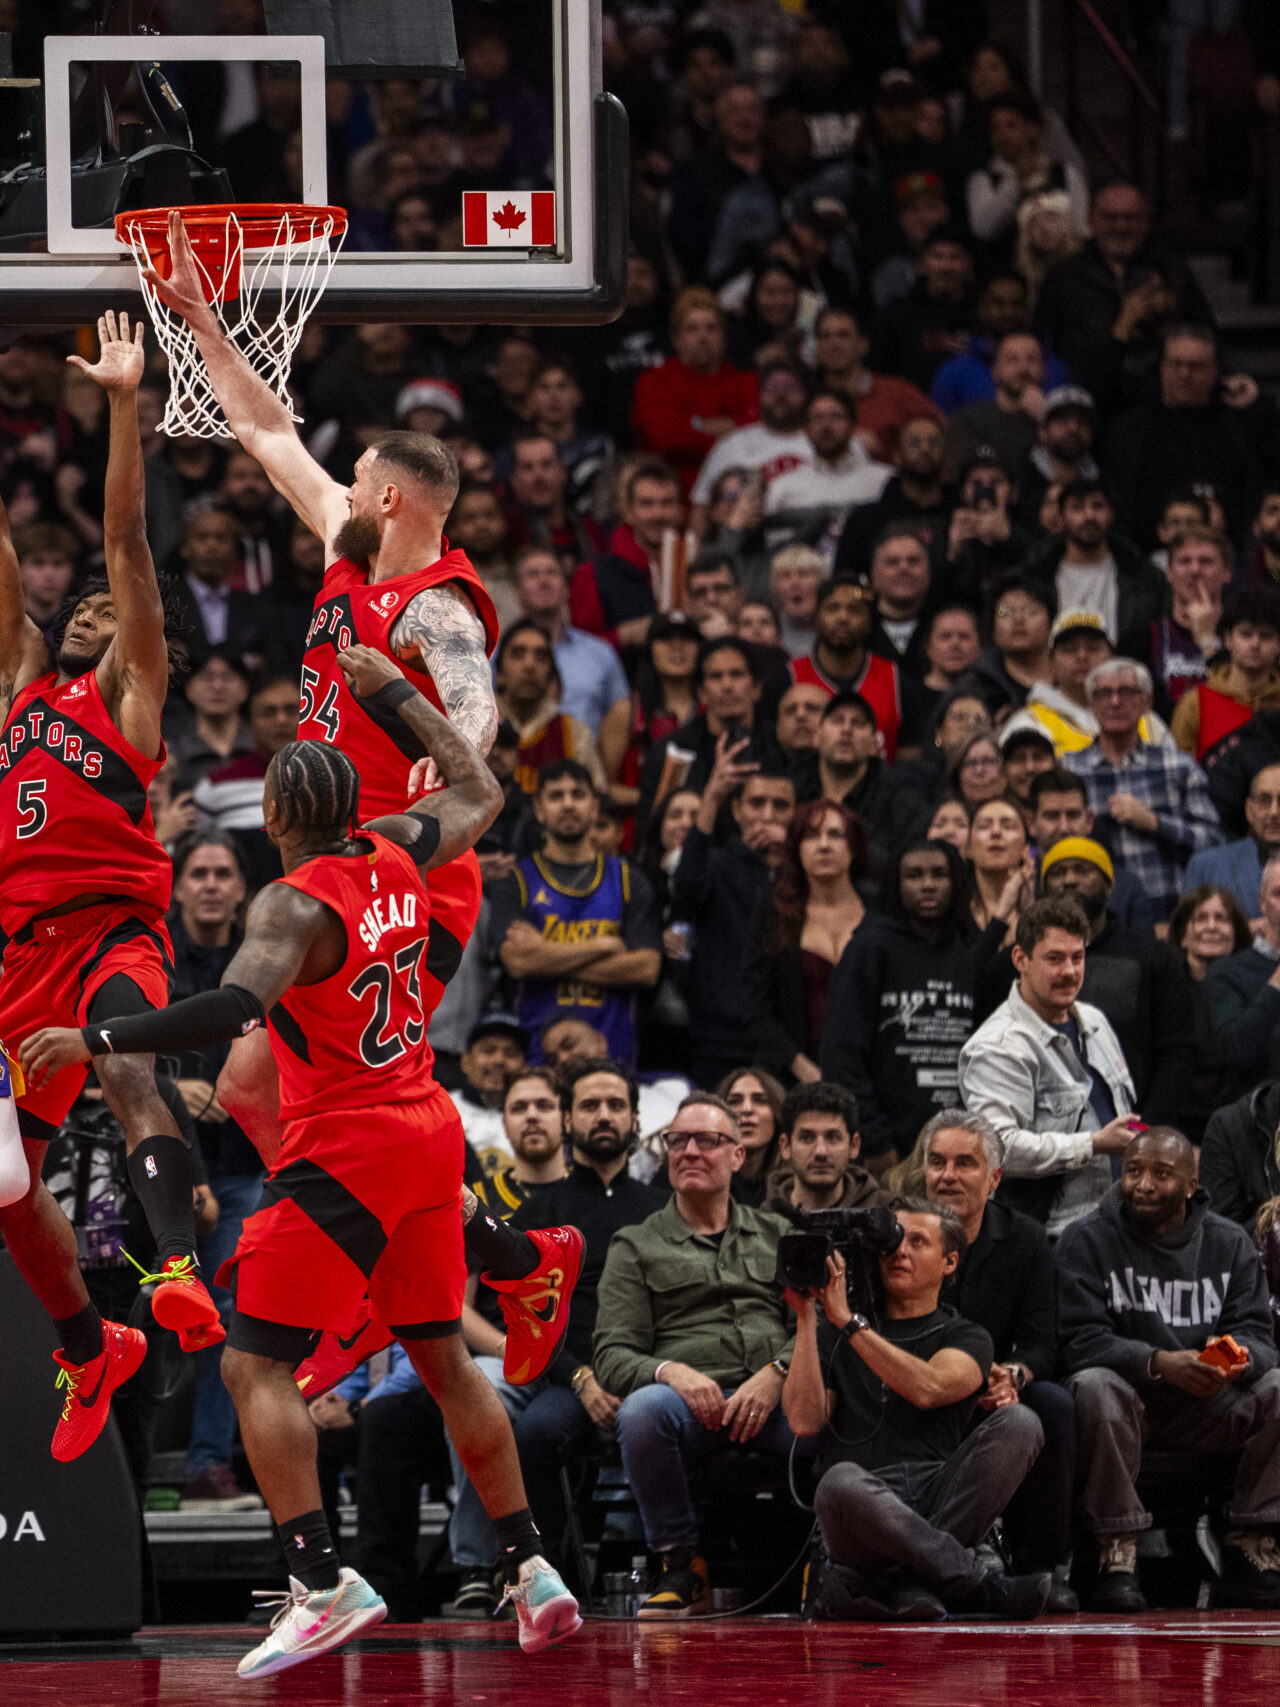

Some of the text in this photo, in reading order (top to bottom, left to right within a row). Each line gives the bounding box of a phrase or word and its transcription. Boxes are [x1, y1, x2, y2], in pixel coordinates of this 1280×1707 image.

[298, 664, 340, 743] 54
[16, 778, 48, 839] 5
[358, 892, 417, 953] SHEAD
[347, 935, 430, 1069] 23
